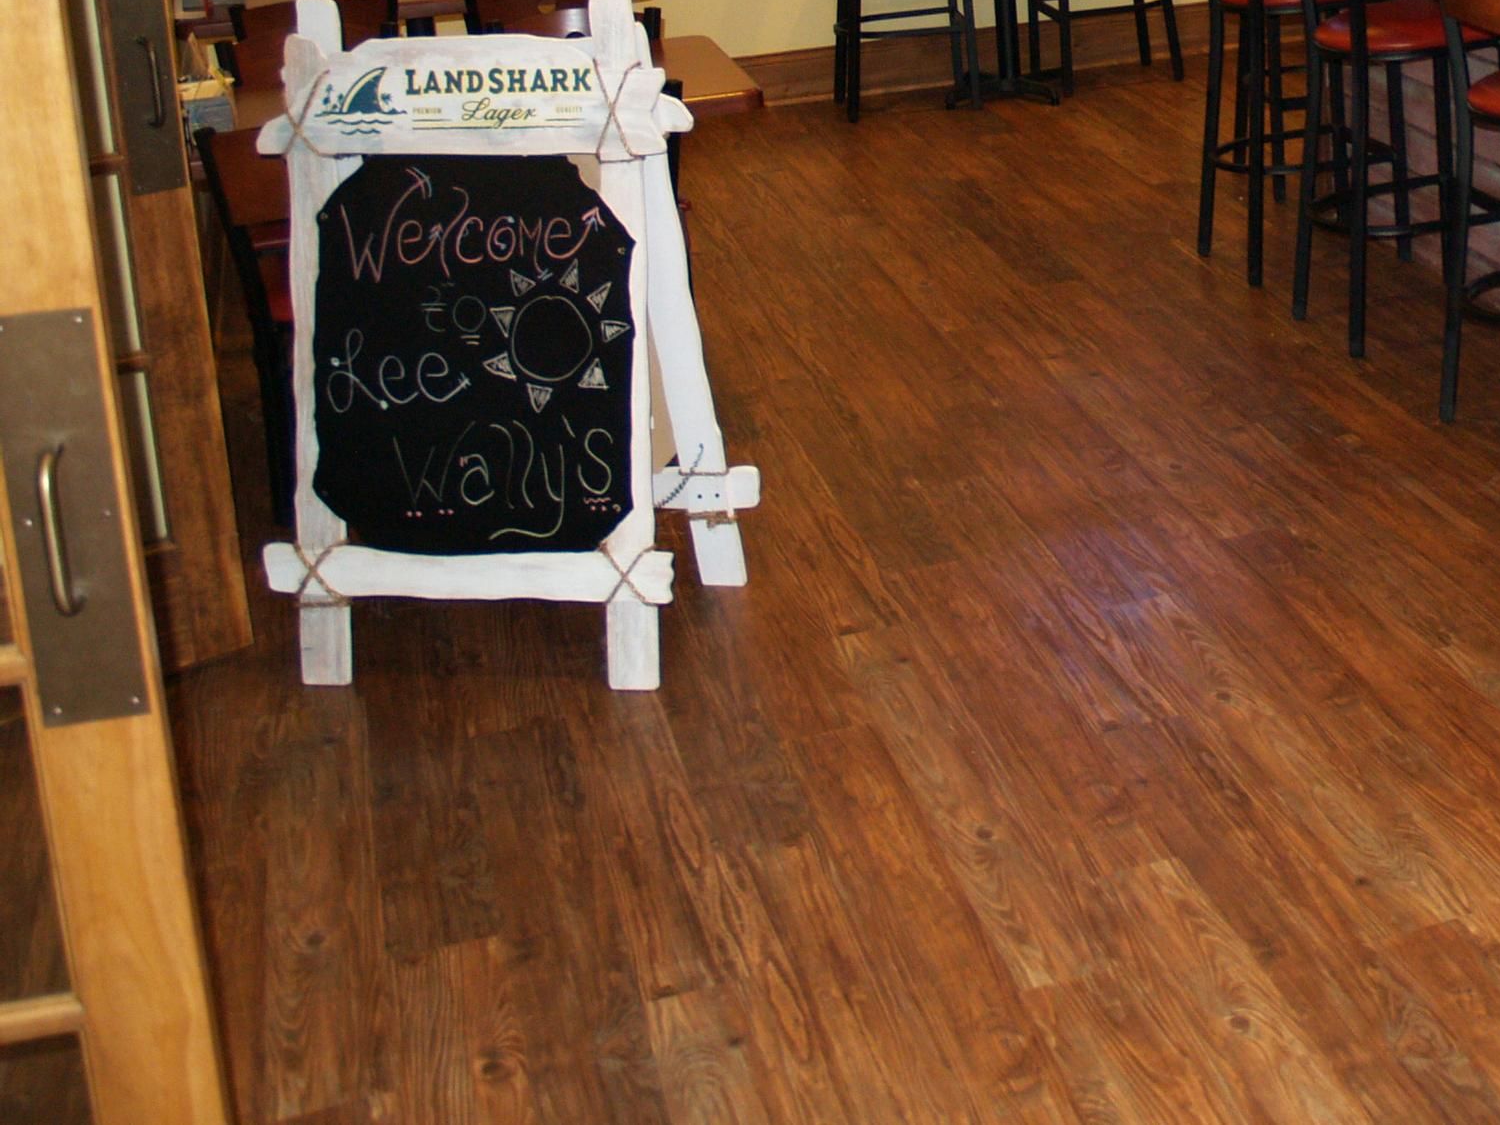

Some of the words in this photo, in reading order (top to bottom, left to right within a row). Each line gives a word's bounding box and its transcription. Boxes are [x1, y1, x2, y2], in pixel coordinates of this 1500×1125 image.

[405, 68, 592, 95] LANDSHARK
[462, 97, 537, 129] Lager
[327, 328, 471, 413] Lee
